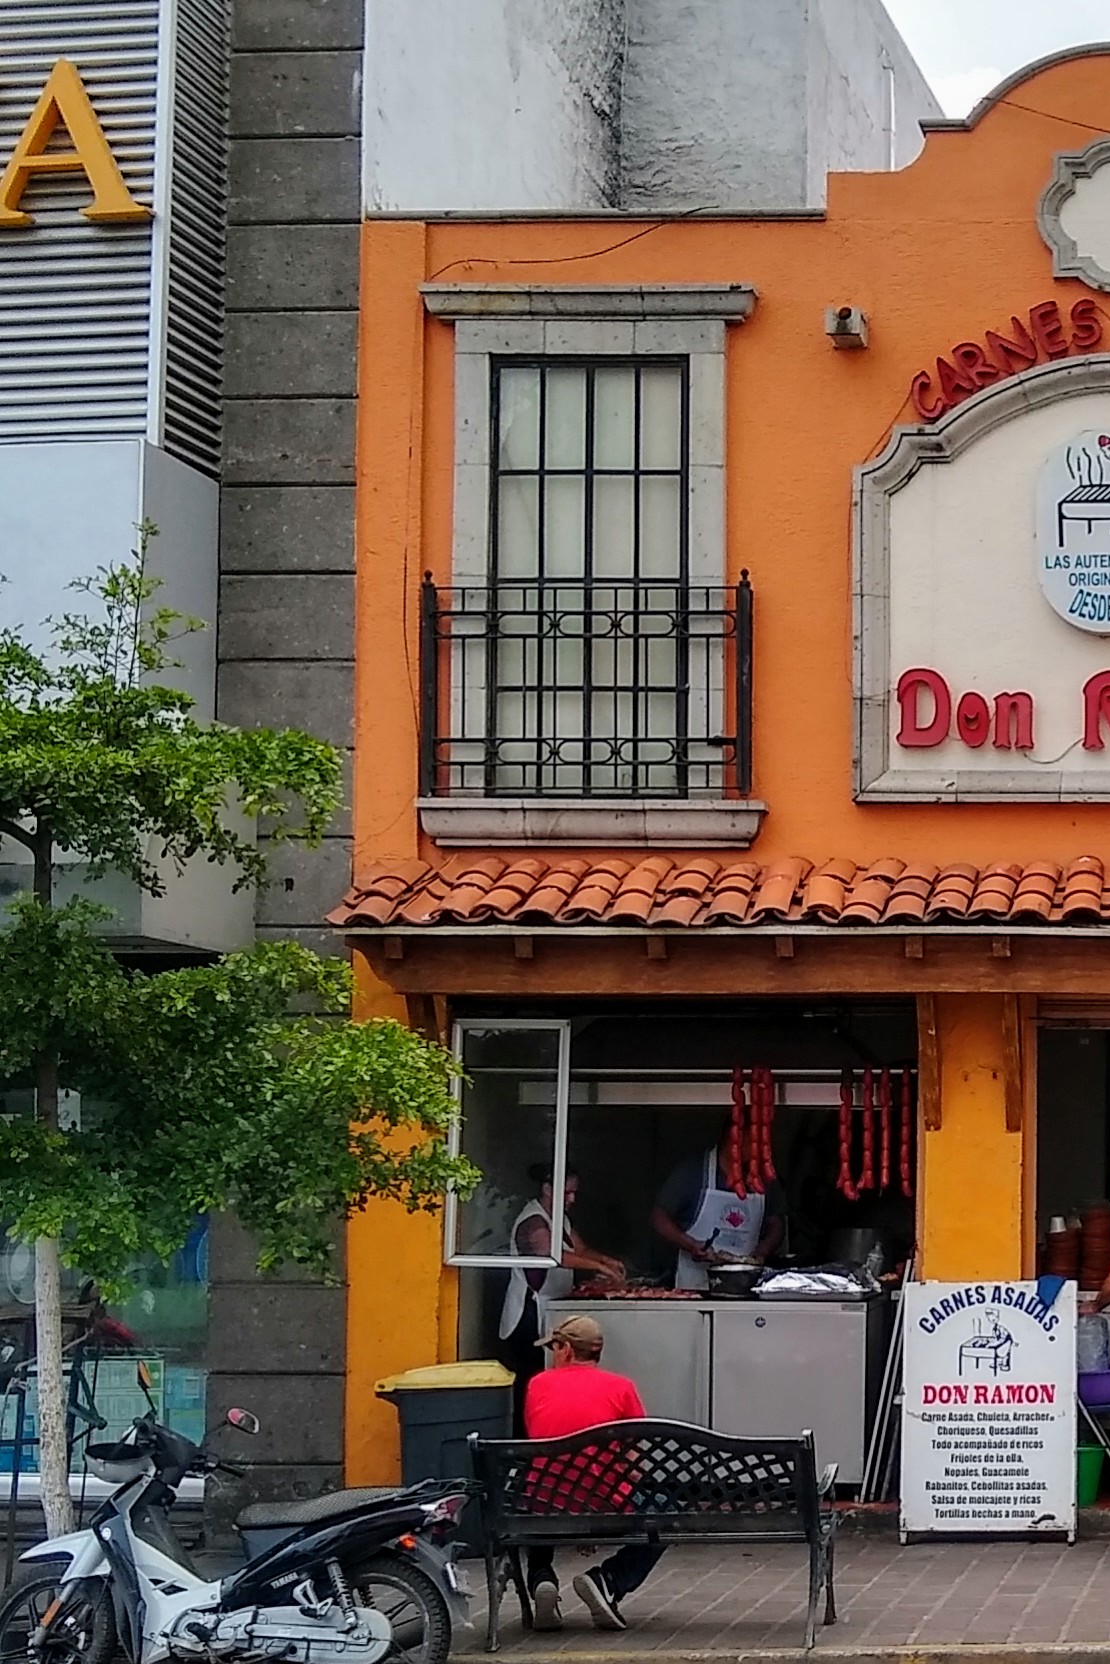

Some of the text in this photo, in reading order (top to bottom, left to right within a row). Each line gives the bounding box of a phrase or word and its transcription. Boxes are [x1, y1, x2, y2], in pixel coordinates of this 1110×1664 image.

[0, 56, 155, 227] A
[911, 298, 1102, 419] CARNES
[1045, 554, 1071, 569] LAS
[895, 667, 1036, 750] Don
[919, 1285, 986, 1334] CARNES
[923, 1384, 1056, 1404] DON RAMON
[921, 1412, 946, 1422] Carne
[1013, 1412, 1055, 1422] Arracher
[989, 1426, 1039, 1436] Quesadillas
[932, 1440, 1044, 1450] Todo acompañado de ricos
[950, 1453, 982, 1464] Frijoles
[984, 1454, 994, 1463] de
[996, 1454, 1004, 1463] la
[982, 1467, 1029, 1476] Guacamole
[971, 1481, 1014, 1490] Cebollitas
[931, 1495, 1041, 1506] Salsa de molcajete y ricas
[935, 1508, 970, 1518] Tortillas
[972, 1508, 1002, 1518] hechas
[1005, 1510, 1010, 1518] a
